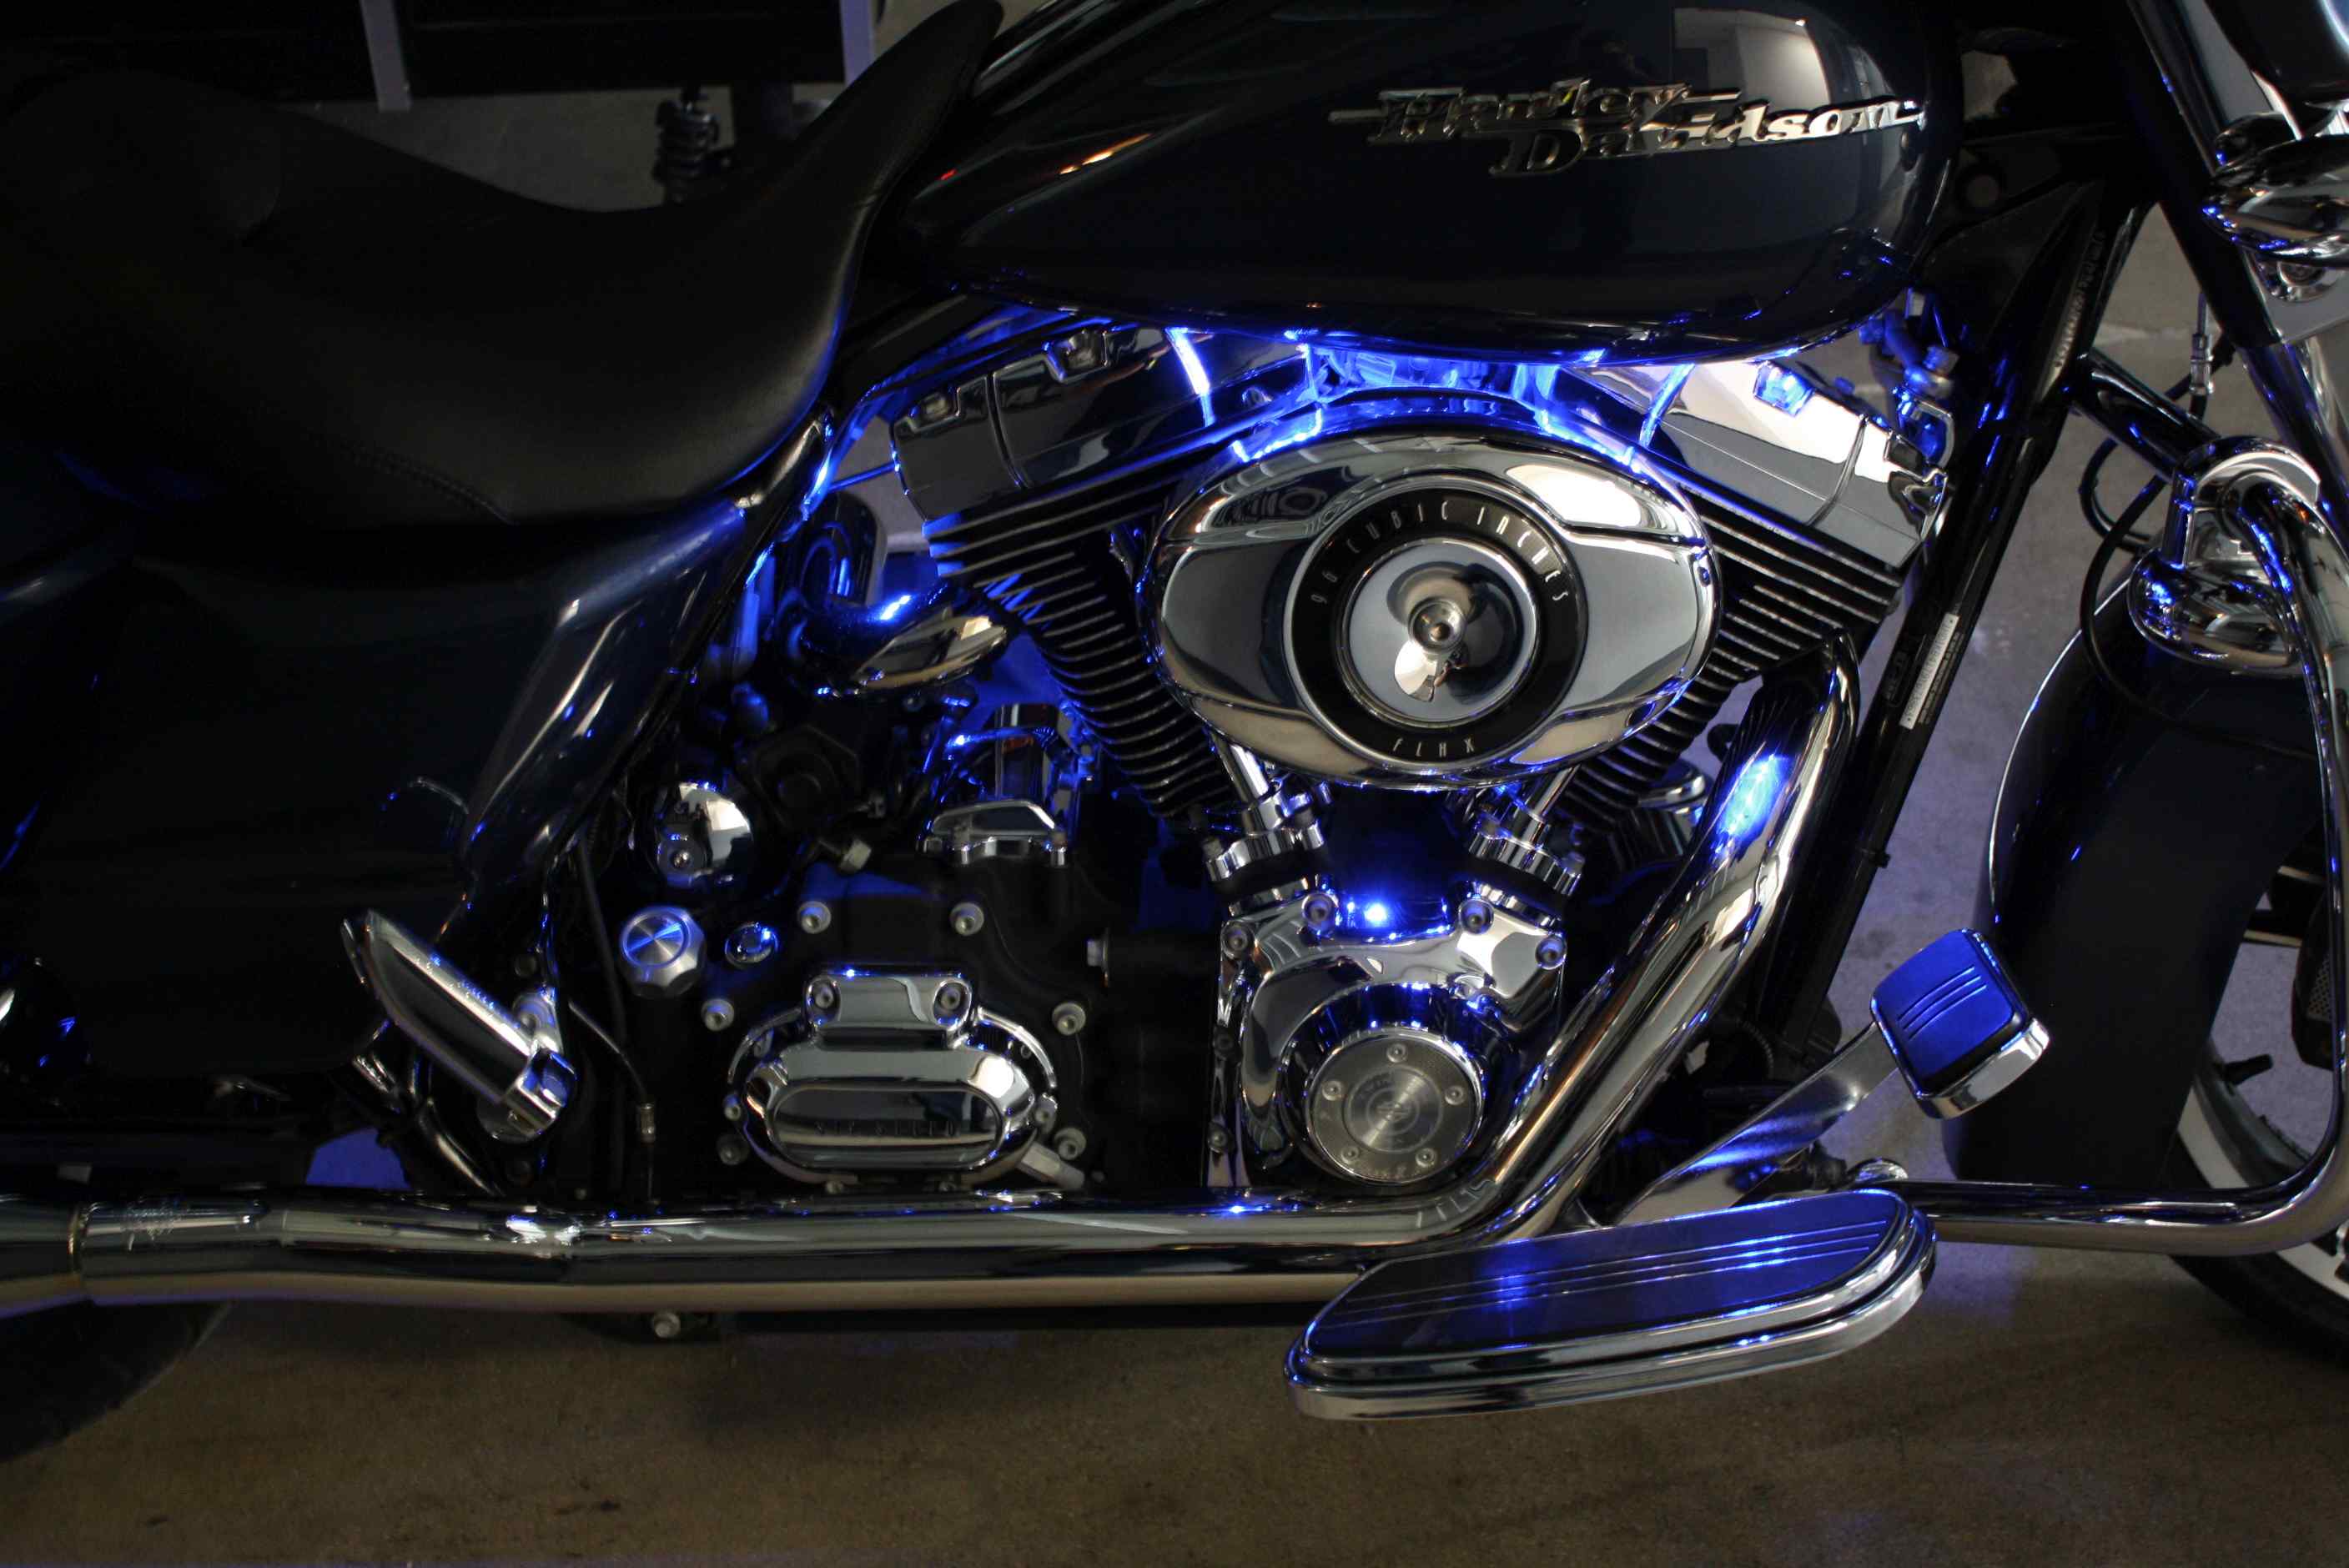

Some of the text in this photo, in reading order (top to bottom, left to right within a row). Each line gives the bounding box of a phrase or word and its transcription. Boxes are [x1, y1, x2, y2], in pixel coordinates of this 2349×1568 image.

[1328, 75, 1742, 146] Harley
[1488, 98, 1926, 177] Davidson
[1346, 500, 1450, 554] CUBIC
[1476, 505, 1569, 601] INCHES
